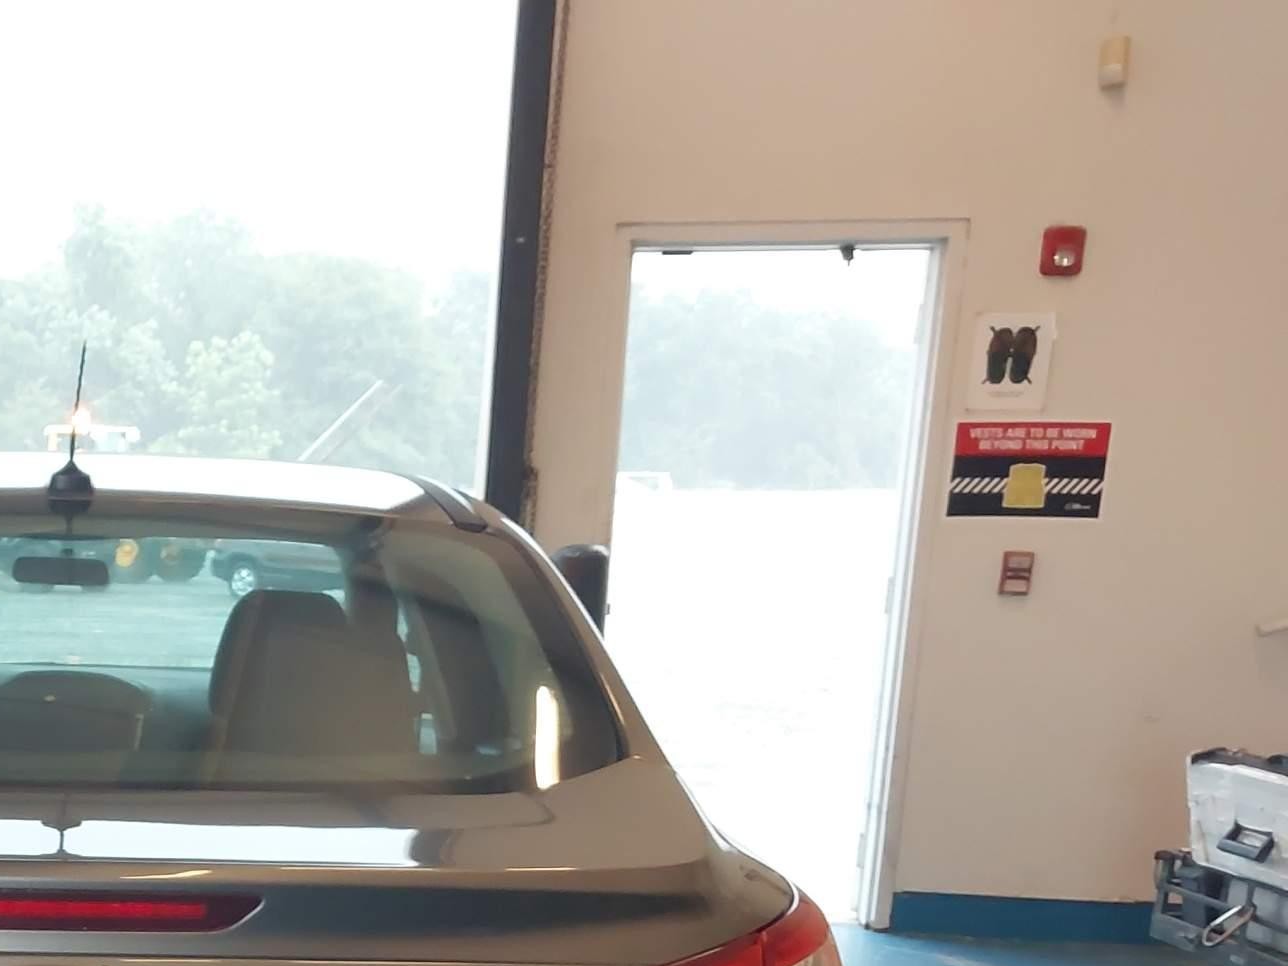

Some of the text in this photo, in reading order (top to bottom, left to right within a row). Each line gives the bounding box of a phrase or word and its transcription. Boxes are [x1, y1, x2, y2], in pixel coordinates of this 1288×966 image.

[969, 427, 1097, 439] VESTS ARE TO BE WORN
[978, 439, 1085, 450] BEYOND THIS POINT
